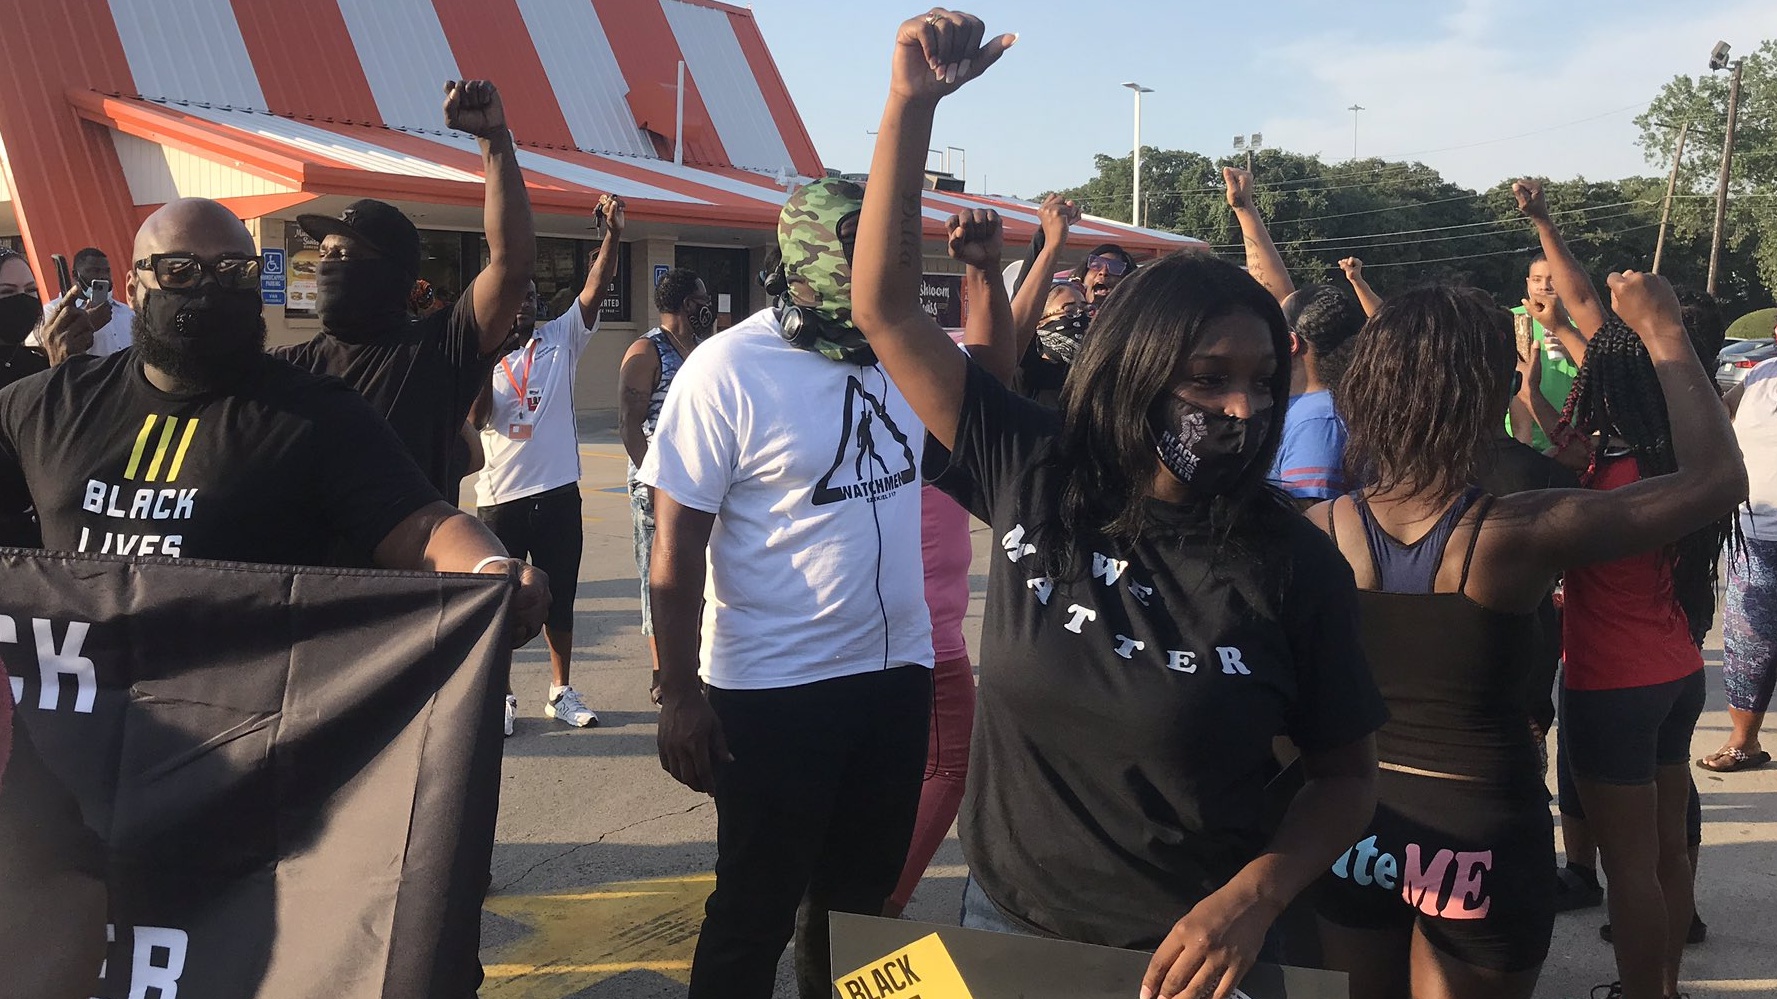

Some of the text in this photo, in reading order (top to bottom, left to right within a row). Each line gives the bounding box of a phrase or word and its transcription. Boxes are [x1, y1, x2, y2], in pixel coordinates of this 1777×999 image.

[1162, 430, 1201, 468] BLACK
[82, 479, 199, 520] BLACK
[840, 472, 905, 500] WATCHMEN
[1402, 842, 1493, 920] ME
[844, 953, 922, 999] BLACK
